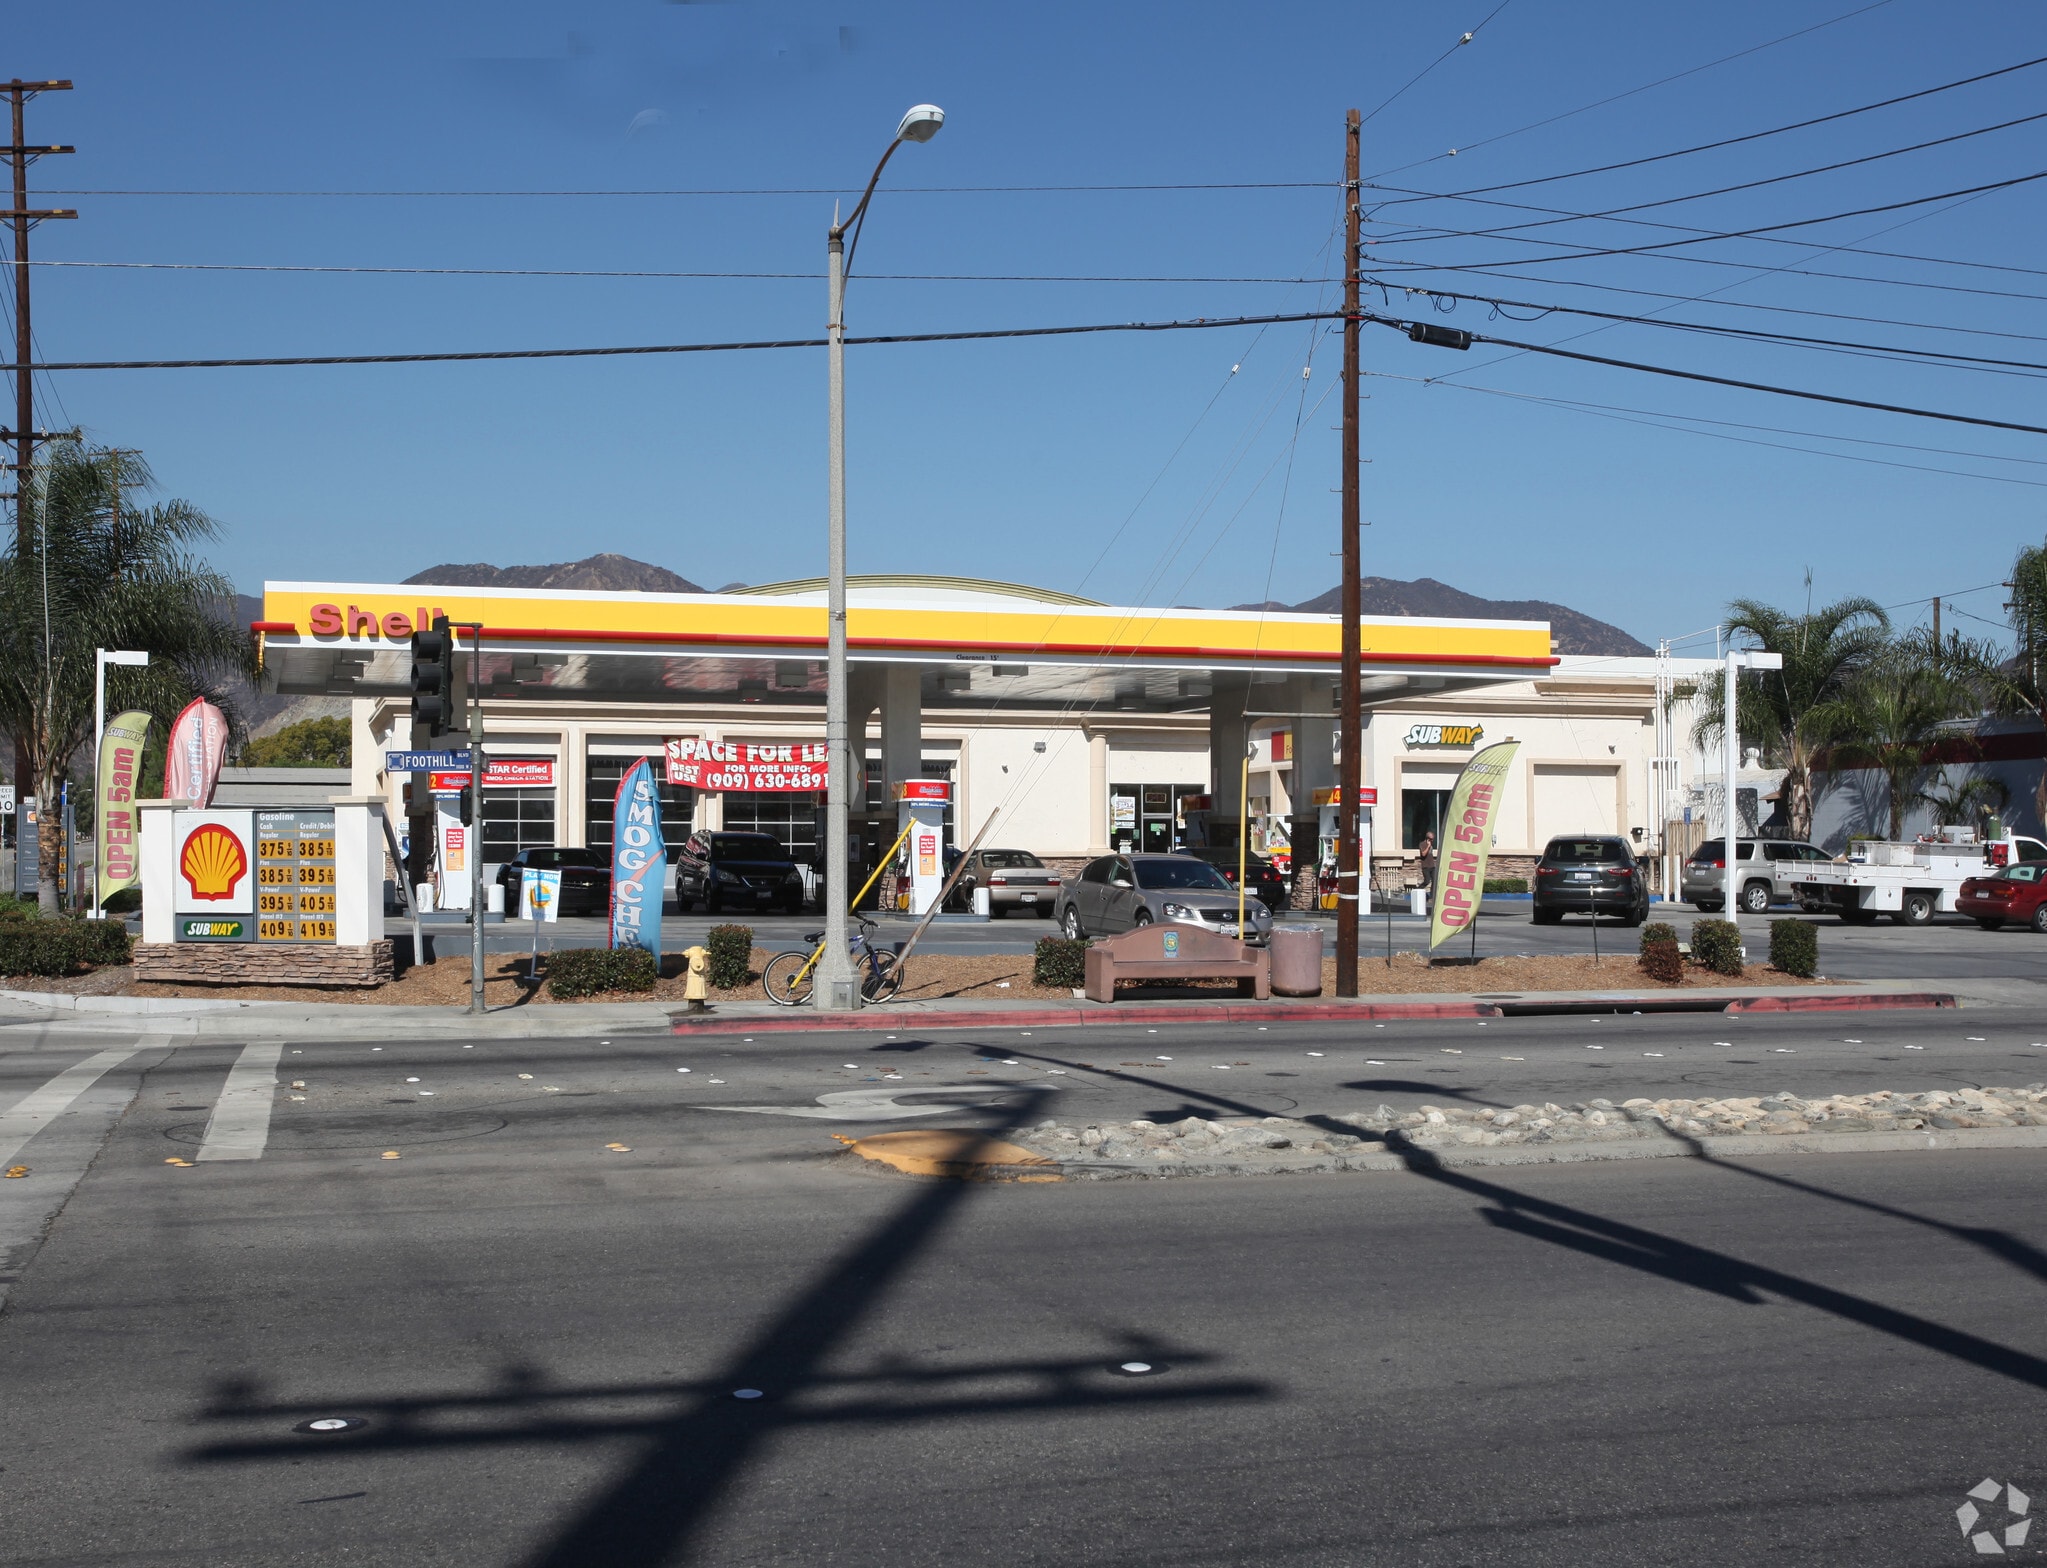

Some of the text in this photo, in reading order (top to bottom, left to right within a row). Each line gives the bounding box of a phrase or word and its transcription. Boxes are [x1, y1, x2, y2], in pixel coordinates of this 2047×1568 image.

[107, 727, 144, 742] SUBWAY
[1403, 724, 1484, 746] SUBWAY
[668, 738, 738, 762] SPACE
[747, 745, 793, 762] FOR
[187, 716, 202, 799] Certified
[406, 755, 455, 768] FOOTHILL
[489, 764, 548, 774] STAR Certified
[671, 762, 699, 775] BEST
[725, 765, 811, 773] FOR MORE INFO:
[430, 774, 437, 788] 2
[674, 773, 697, 783] USE
[706, 773, 749, 790] (909)
[107, 747, 134, 879] OPEN 5am
[260, 812, 295, 821] Gasoline
[260, 822, 273, 830] Cash
[299, 822, 335, 830] Credit/Debit
[618, 779, 655, 871] SMOG
[300, 831, 320, 839] Regular
[260, 842, 284, 856] 375
[299, 842, 324, 856] 385
[1440, 783, 1495, 927] OPEN 5am
[260, 869, 284, 882] 385
[299, 868, 325, 882] 395
[261, 896, 284, 910] 395
[300, 896, 325, 910] 405
[187, 922, 239, 936] SUBWAY
[261, 921, 285, 936] 409
[301, 922, 326, 936] 419
